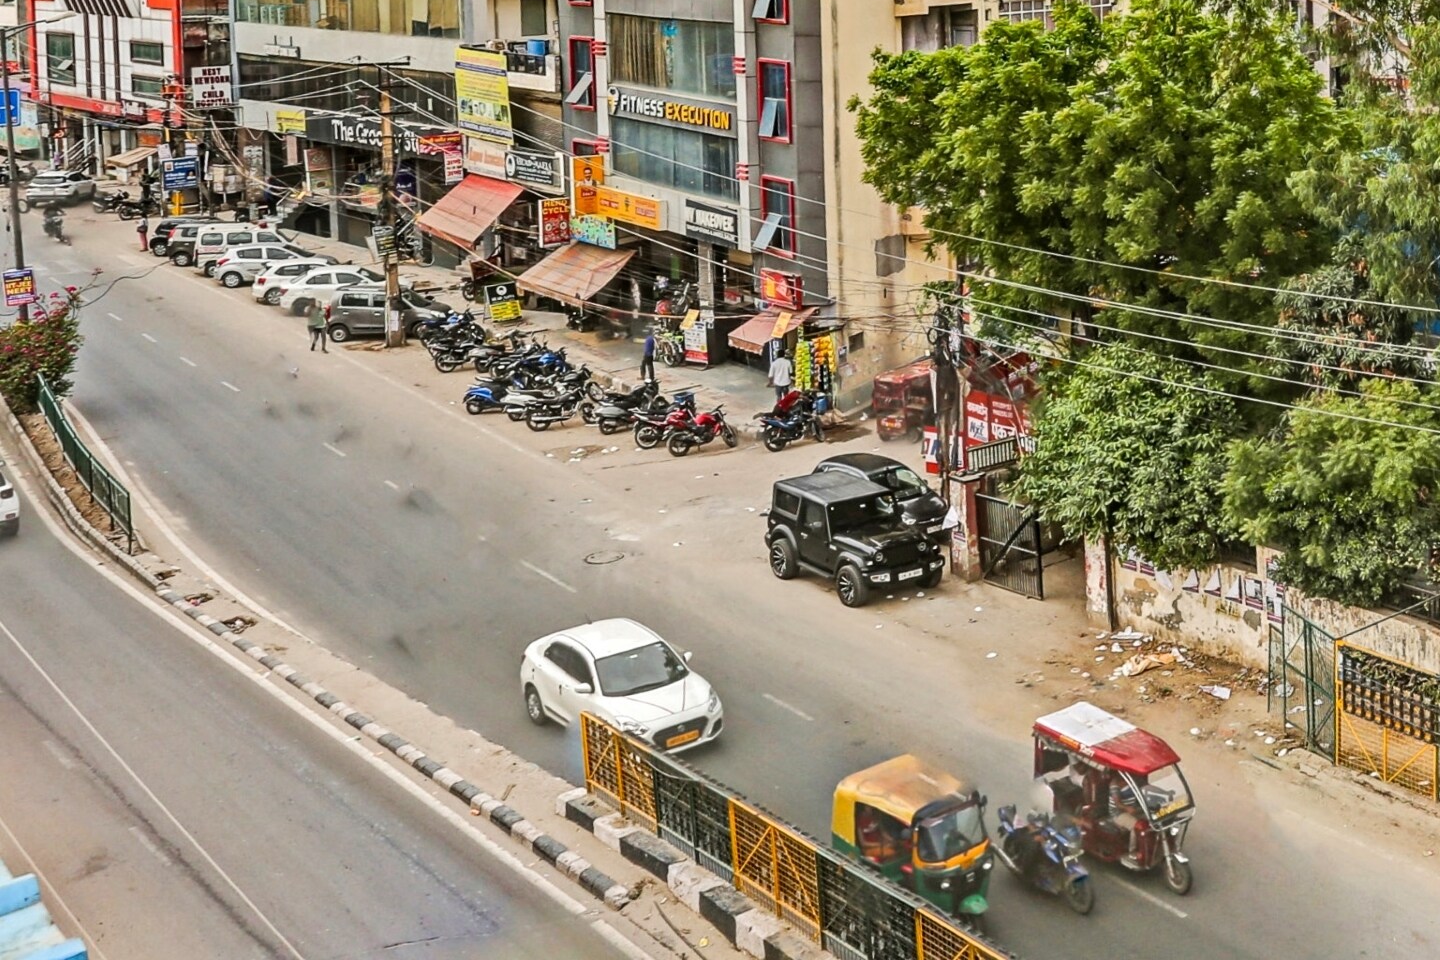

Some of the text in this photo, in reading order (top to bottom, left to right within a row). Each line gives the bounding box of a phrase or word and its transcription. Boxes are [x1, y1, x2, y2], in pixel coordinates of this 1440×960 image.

[202, 68, 221, 76] NEST
[194, 75, 230, 85] NEWBORN
[202, 91, 224, 99] CHILD
[620, 94, 730, 130] FITNESS EXECUTION
[331, 119, 354, 142] The
[356, 123, 402, 153] Grocy
